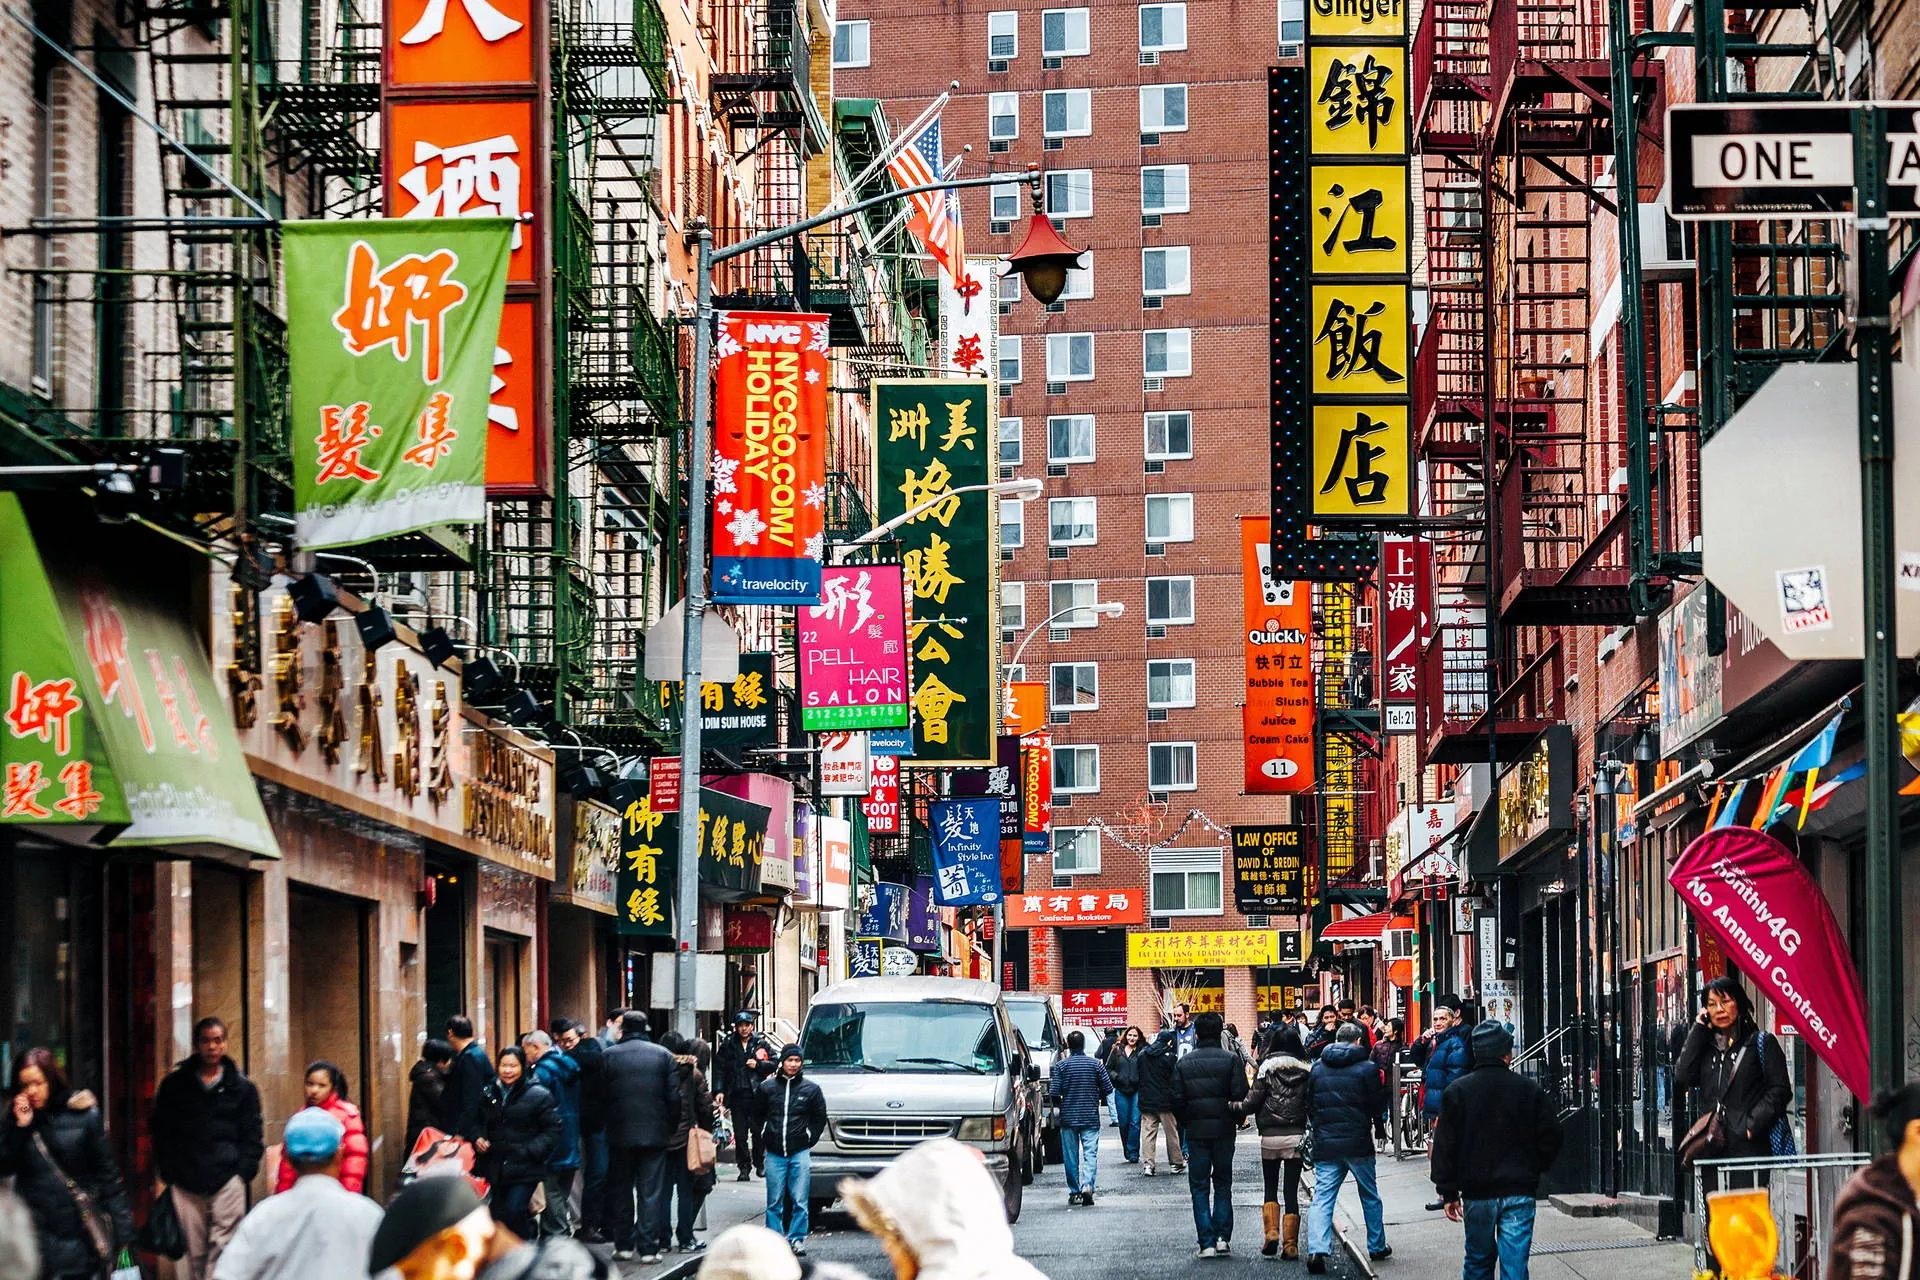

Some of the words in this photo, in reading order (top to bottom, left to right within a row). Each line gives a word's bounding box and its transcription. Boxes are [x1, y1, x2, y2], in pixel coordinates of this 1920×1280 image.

[1314, 0, 1401, 24] Ginger
[1720, 141, 1813, 180] ONE
[1315, 54, 1406, 506] 錦江飯店
[746, 324, 801, 344] NYC
[744, 351, 771, 481] HOLIDAY
[769, 352, 799, 547] NYCGO.COM/
[742, 578, 807, 593] travelocity
[802, 631, 818, 643] 22
[1249, 629, 1308, 645] Quickly
[808, 648, 865, 675] PELL
[1255, 655, 1303, 670] 快可立
[849, 667, 902, 685] HAIR
[1249, 678, 1284, 688] Bubble
[1290, 678, 1309, 688] Tea
[807, 687, 903, 706] SALON
[1275, 697, 1310, 707] Slush
[807, 706, 903, 719] 212-233-6789
[1387, 711, 1415, 725] Tel:21
[705, 717, 720, 730] DIM
[721, 716, 739, 729] SUM
[740, 715, 767, 728] HOUSE
[1261, 715, 1297, 726] Juice
[1249, 735, 1281, 744] Cream
[1285, 735, 1309, 744] Cake
[821, 761, 864, 771] 妝品專門店
[1271, 762, 1289, 776] 11
[821, 773, 863, 783] 容減肥中心
[871, 774, 897, 787] ACK
[1028, 749, 1040, 827] NYCGO.COM/
[875, 789, 885, 802] &
[862, 802, 897, 815] FOOT
[868, 817, 893, 829] RUB
[964, 807, 980, 835] 天地
[1024, 840, 1045, 849] velocity
[1237, 833, 1260, 846] LAW
[1263, 831, 1298, 847] OFFICE
[948, 843, 981, 853] Infinity
[1261, 847, 1275, 856] OF
[957, 852, 979, 862] Style
[980, 852, 994, 861] Inc
[1238, 857, 1261, 869] DAVID
[1263, 858, 1272, 868] A.
[1273, 856, 1300, 868] BREDIN
[1022, 894, 1129, 912] 萬有書局
[1039, 914, 1074, 922] Confucius
[1686, 876, 1713, 906] No
[1713, 905, 1773, 969] Annual
[1771, 966, 1838, 1049] Contract
[1097, 1005, 1128, 1013] Bookstor
